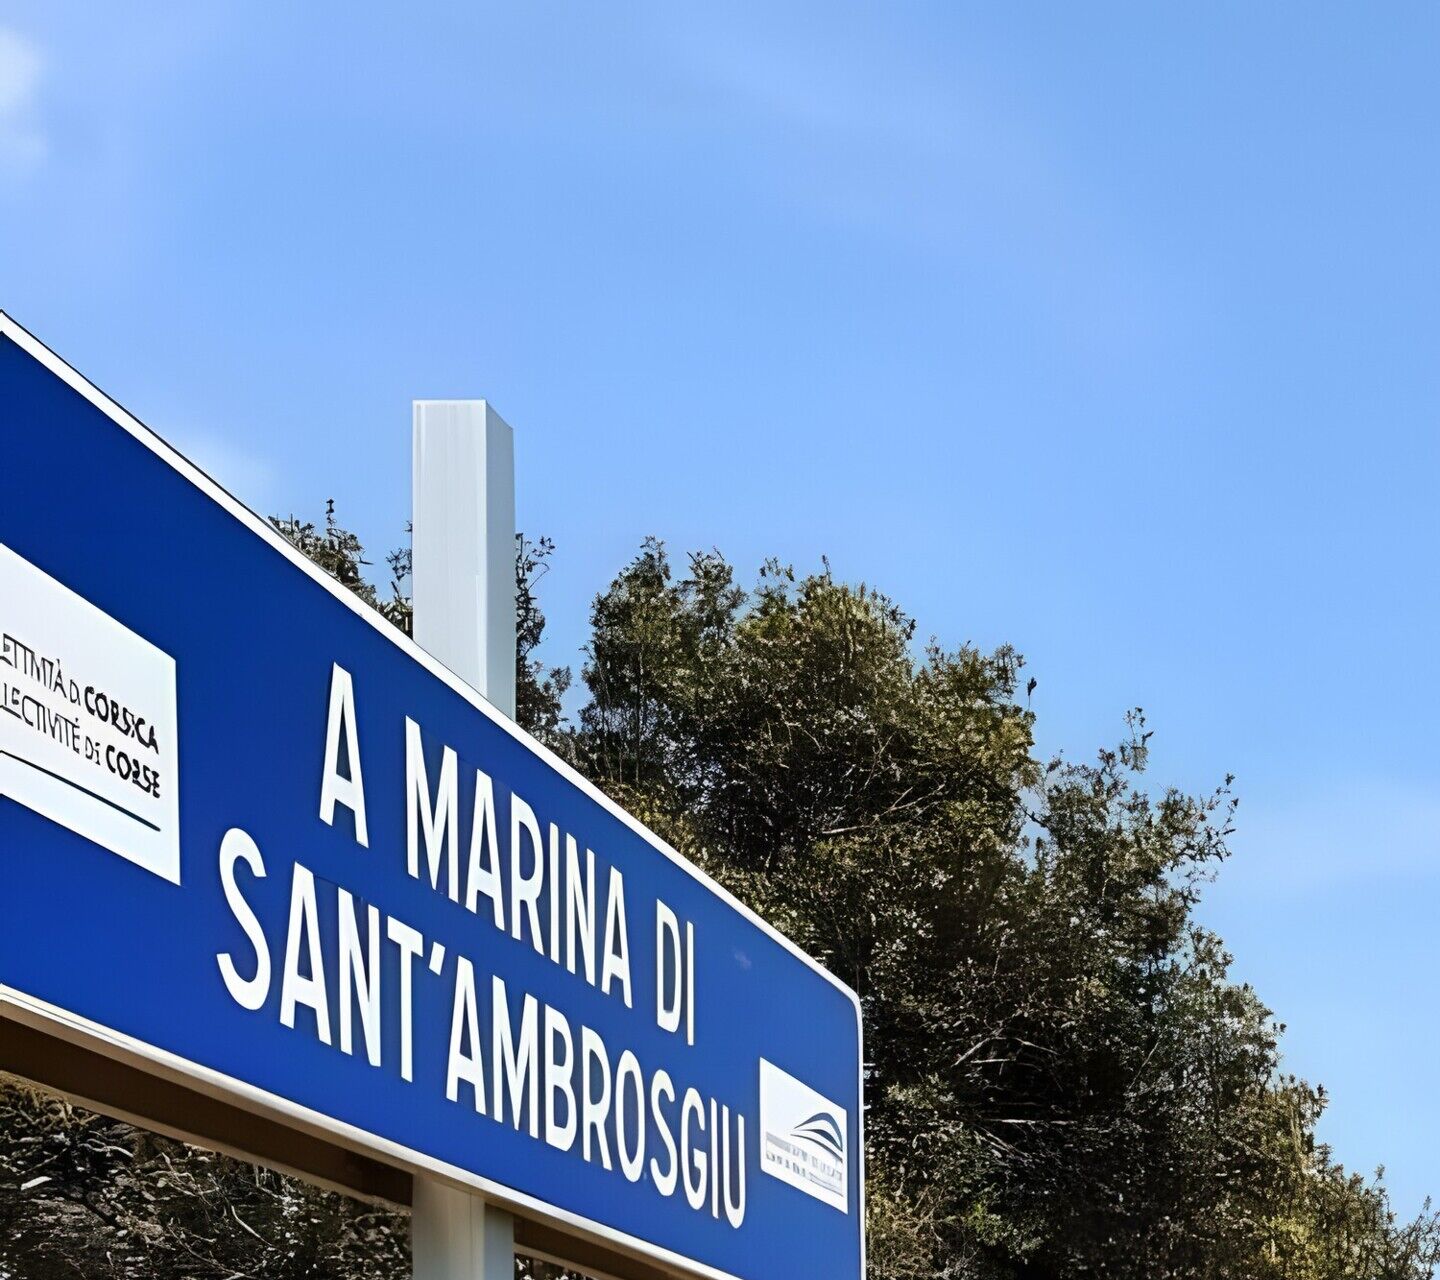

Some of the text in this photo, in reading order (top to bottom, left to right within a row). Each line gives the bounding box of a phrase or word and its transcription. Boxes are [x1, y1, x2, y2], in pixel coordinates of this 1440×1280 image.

[84, 686, 159, 755] CORSICA
[106, 744, 160, 799] CORSE
[319, 661, 694, 1046] A MARINA DI
[216, 827, 746, 1230] SANT'AMBROSGIU
